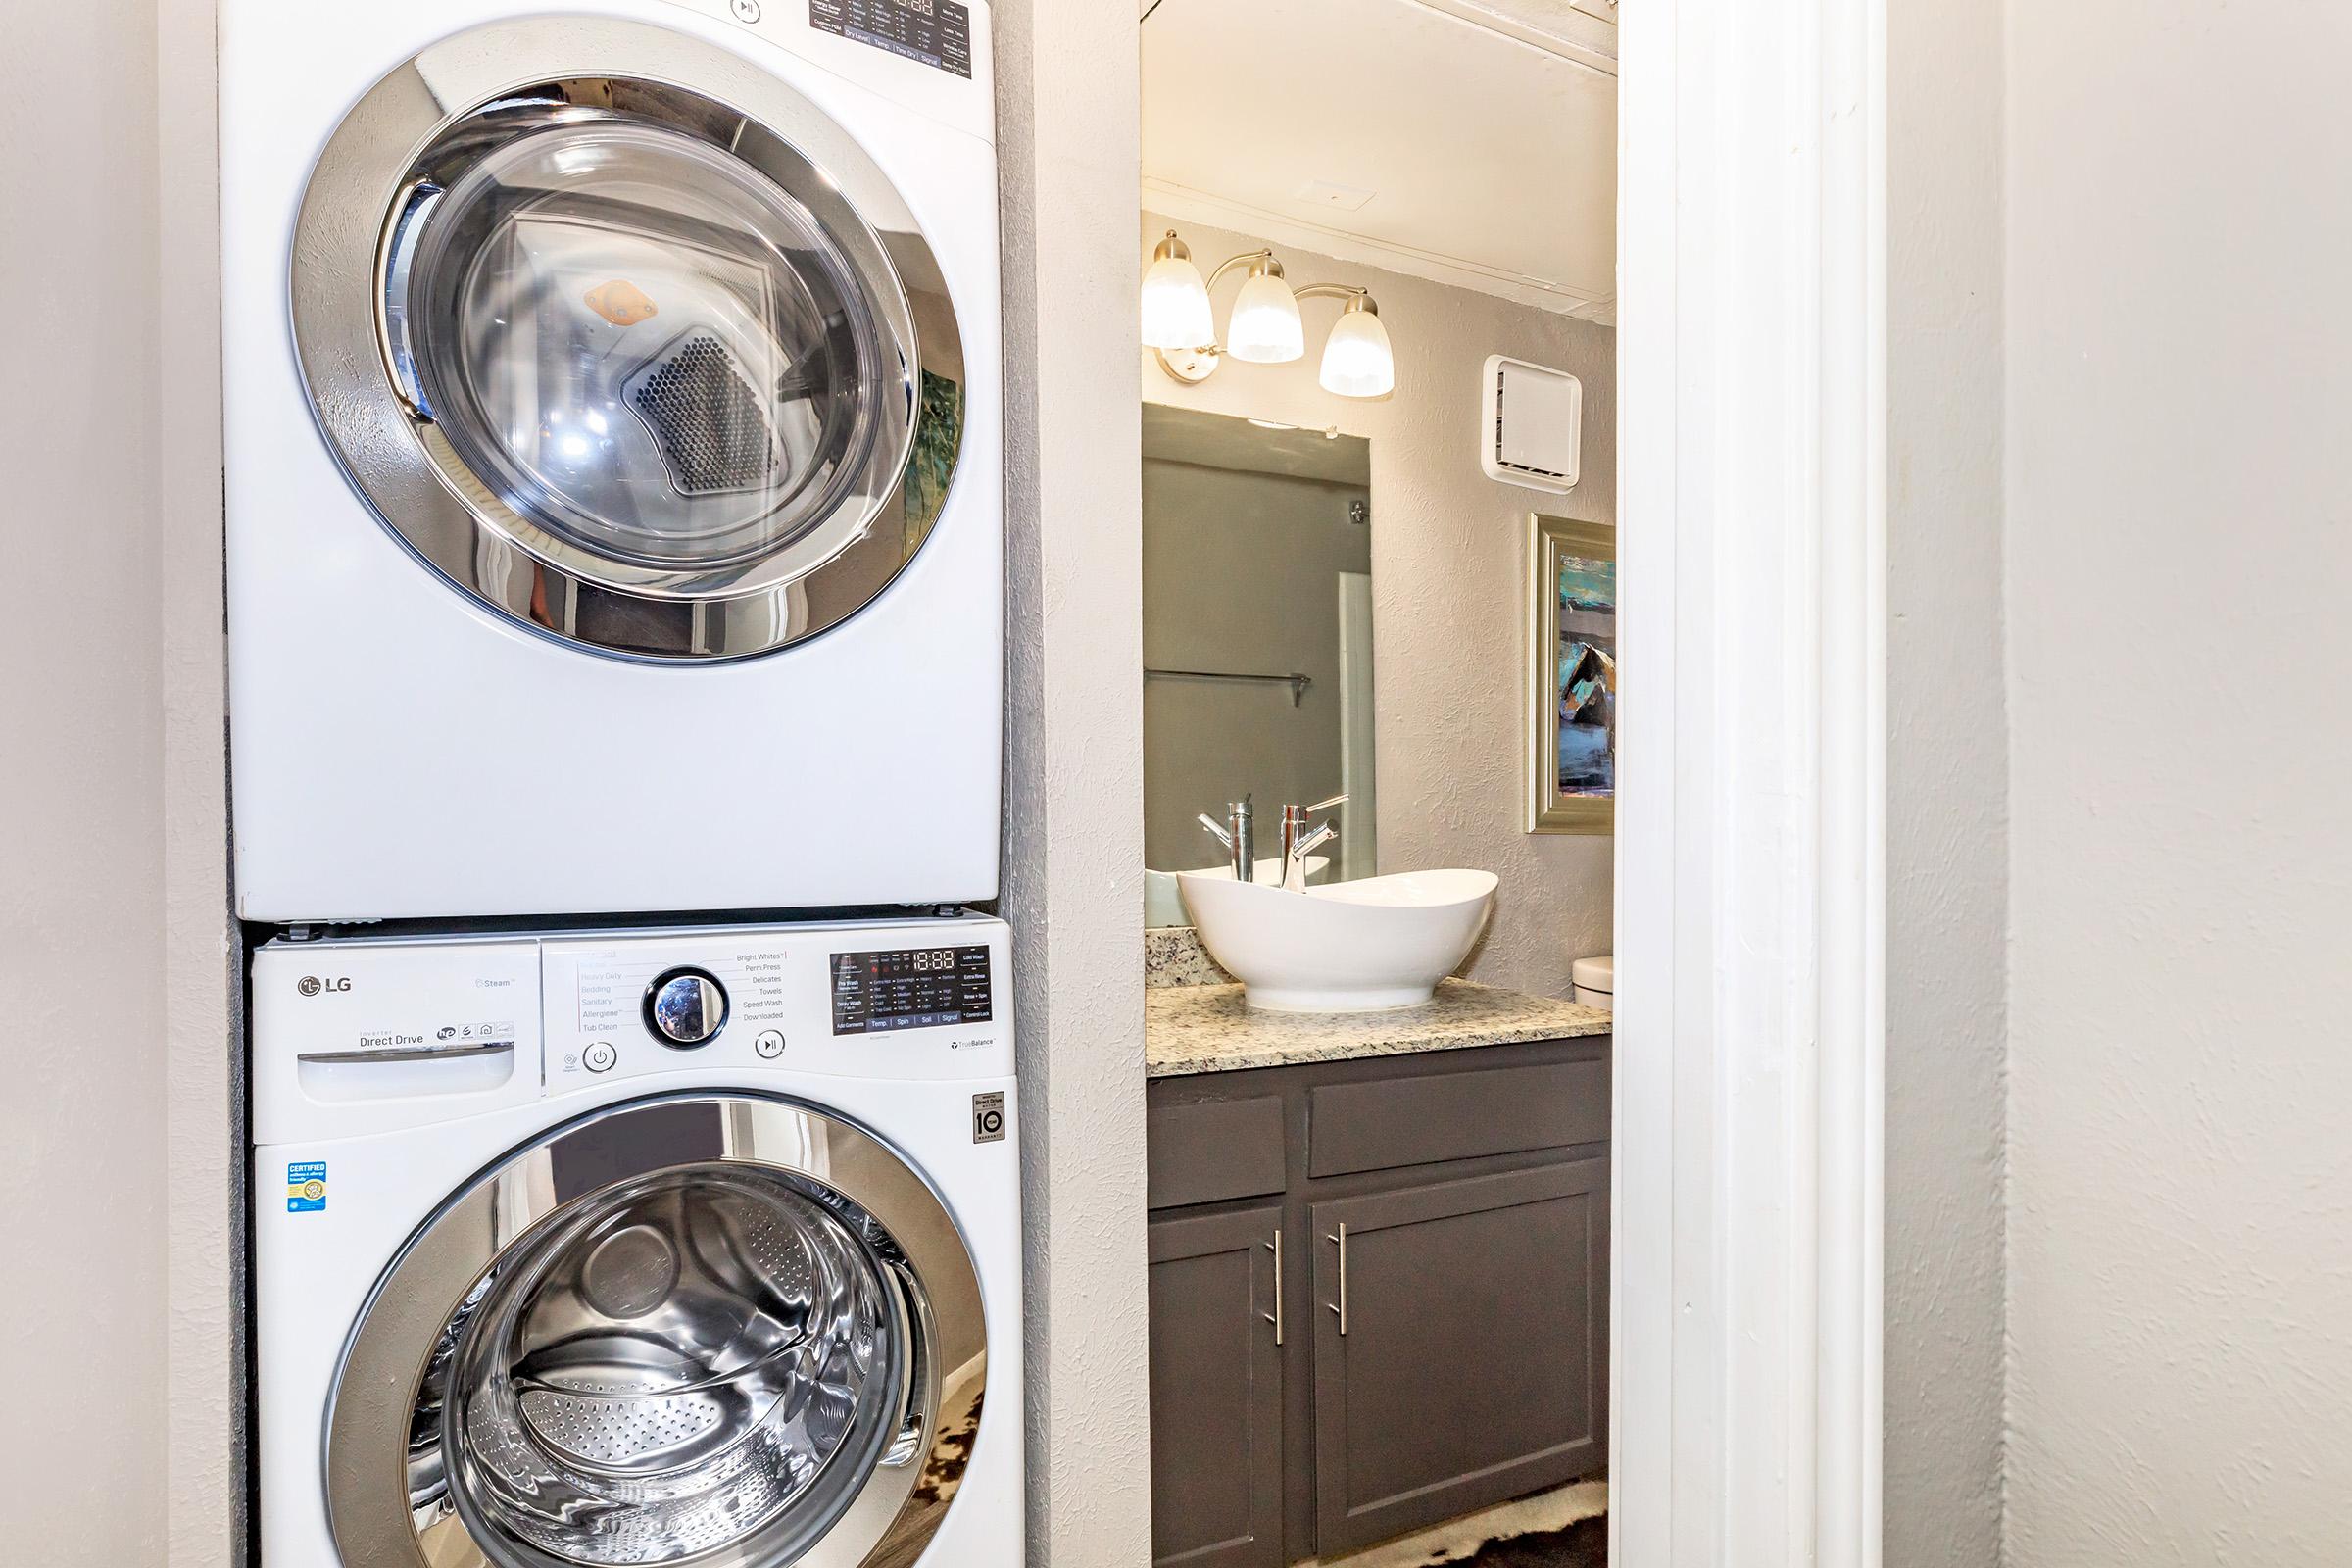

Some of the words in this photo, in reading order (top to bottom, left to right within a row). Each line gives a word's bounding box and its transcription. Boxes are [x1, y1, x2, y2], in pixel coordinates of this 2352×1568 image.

[845, 30, 855, 39] Dry
[856, 33, 869, 42] Level
[896, 46, 907, 55] Time
[907, 50, 917, 59] Dry
[921, 55, 938, 65] Signal
[758, 952, 781, 960] Whites
[326, 978, 351, 992] LG
[743, 1000, 763, 1009] Speed
[744, 1012, 784, 1021] Downloaded
[360, 1037, 392, 1047] Direct
[395, 1034, 423, 1045] Drive
[977, 1111, 1002, 1134] 10
[290, 1163, 325, 1173] CERTIFIED
